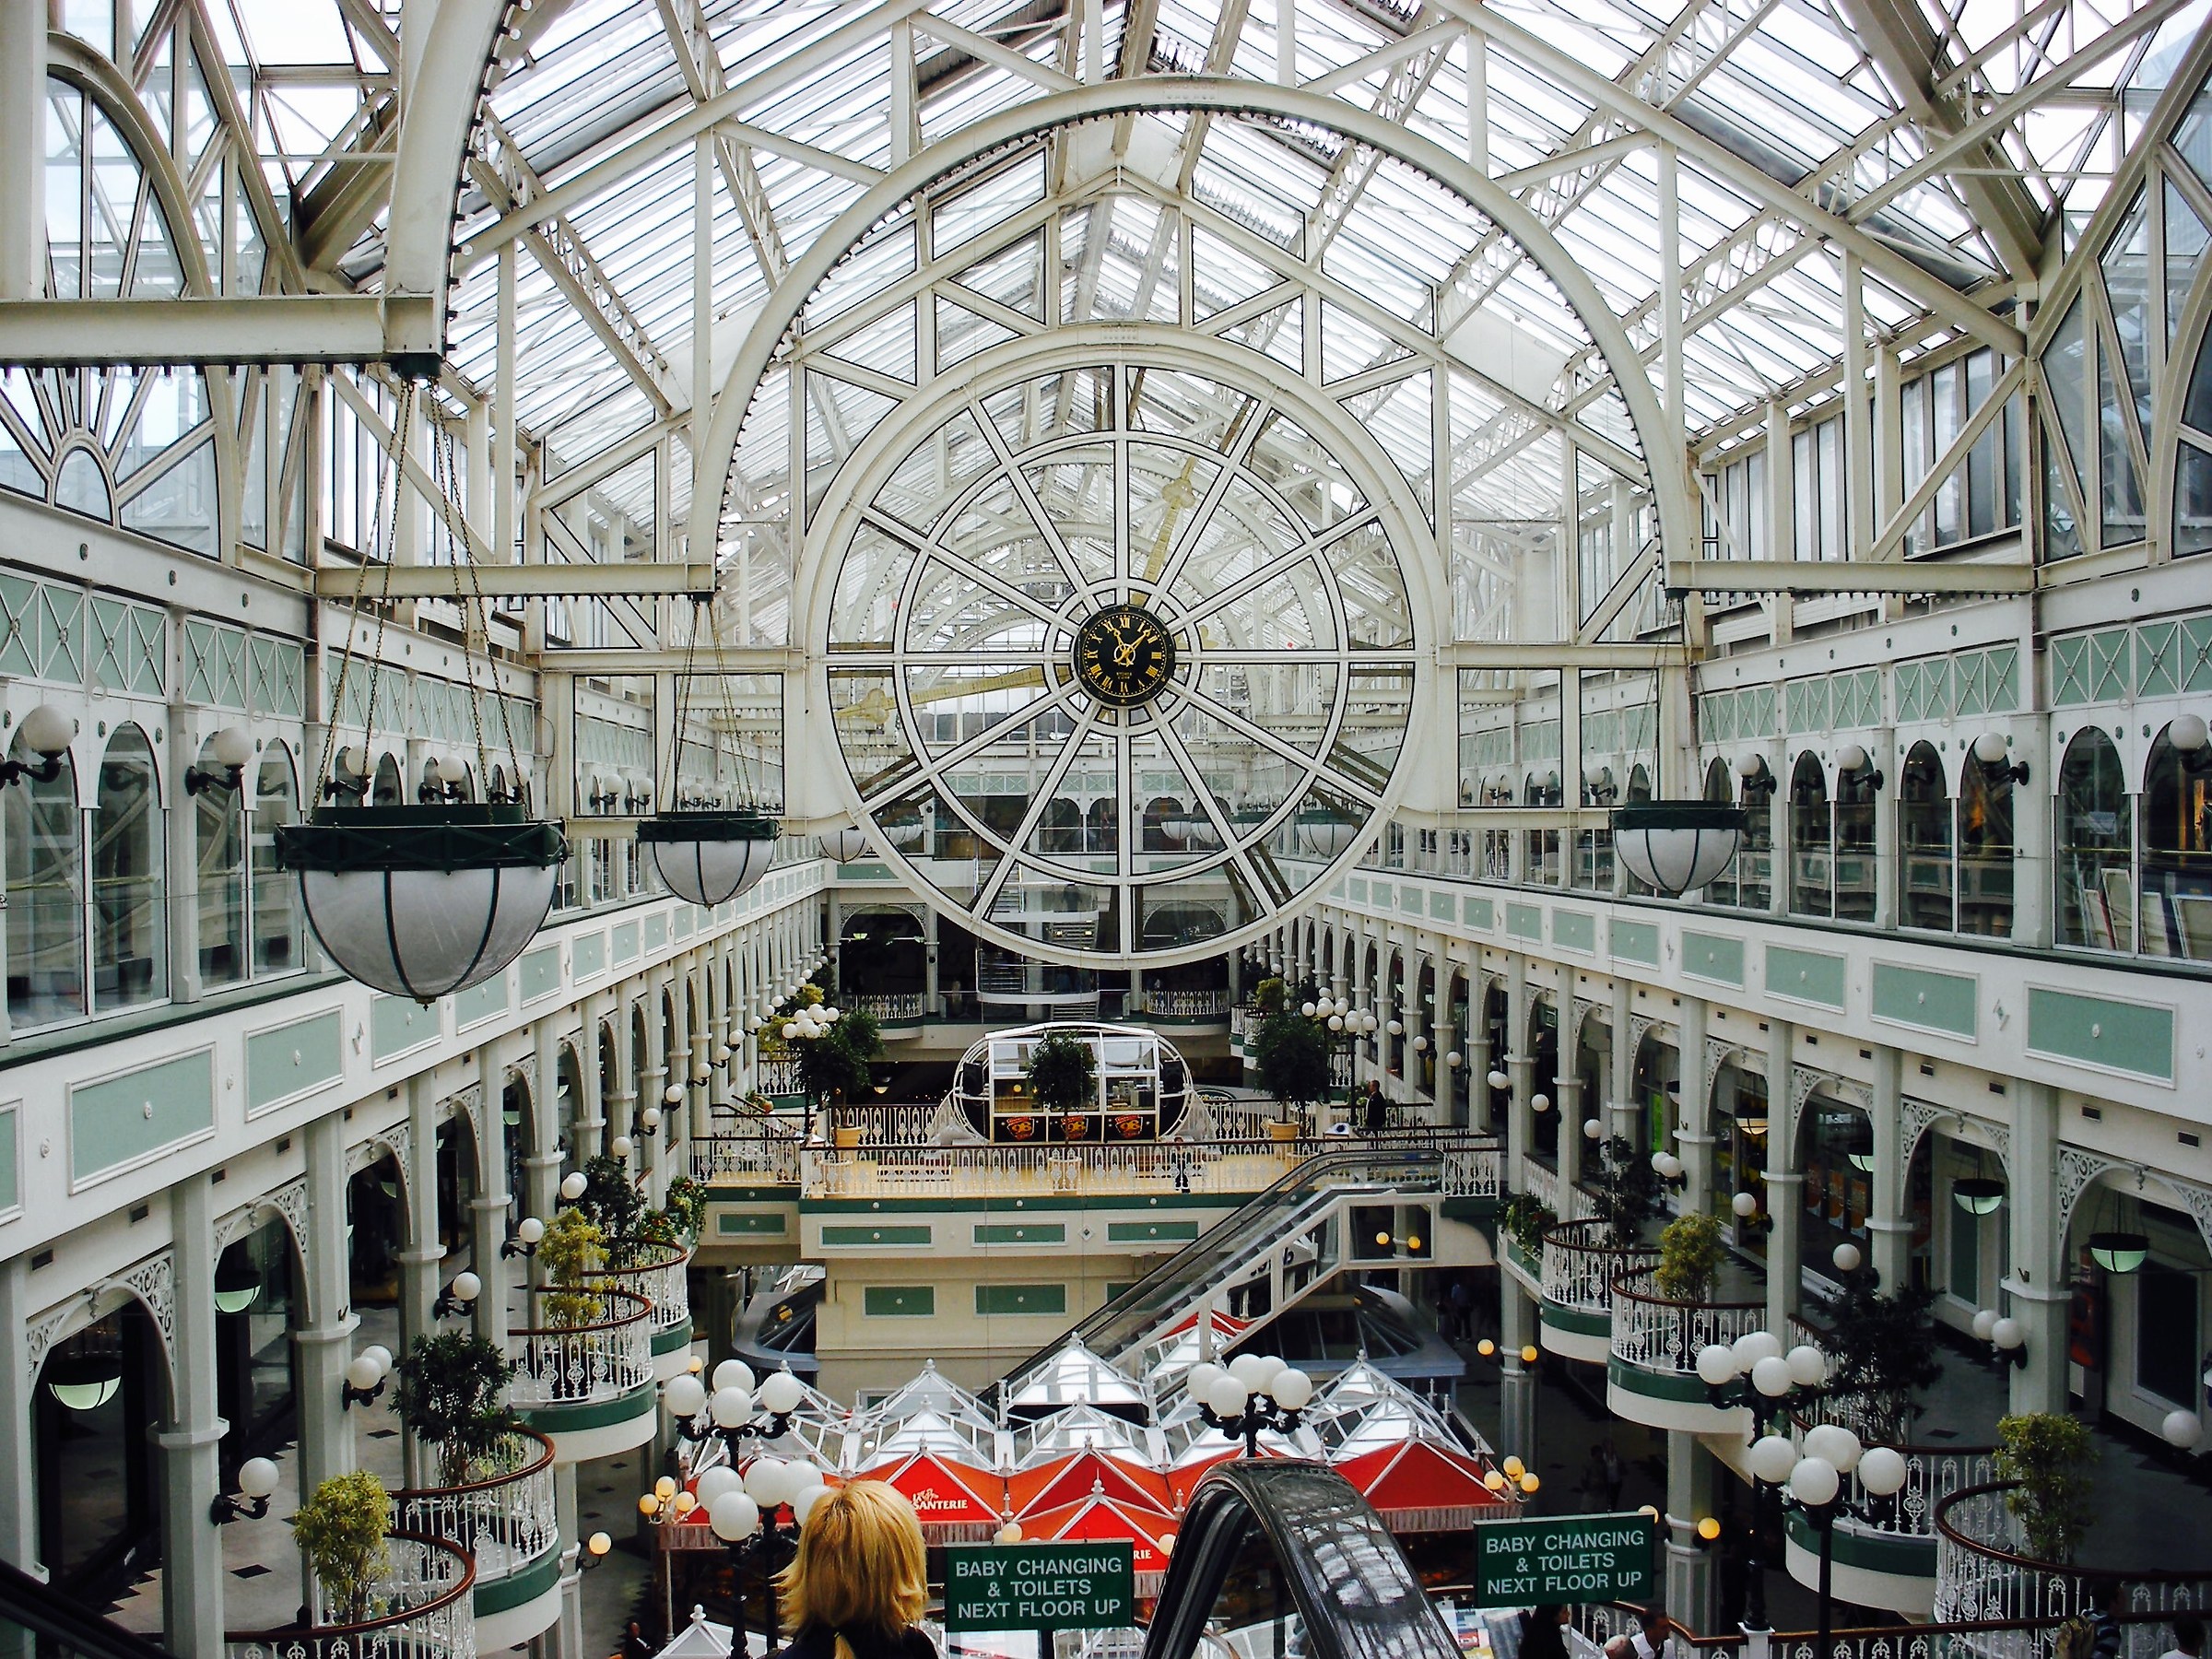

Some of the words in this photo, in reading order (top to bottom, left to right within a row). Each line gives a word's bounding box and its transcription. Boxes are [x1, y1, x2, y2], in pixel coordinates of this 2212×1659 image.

[1120, 618, 1131, 629] XII
[1091, 633, 1103, 644] X
[1151, 652, 1162, 660] III
[912, 1500, 968, 1511] SANTERIE
[1487, 1536, 1535, 1553] BABY
[1545, 1531, 1643, 1550] CHANGING
[957, 1561, 1007, 1576] BABY
[1017, 1558, 1122, 1575] CHANGING
[1516, 1558, 1528, 1572] &
[1538, 1553, 1614, 1571] TOILETS
[988, 1583, 1000, 1597] &
[1010, 1580, 1090, 1596] TOILETS
[1488, 1578, 1536, 1594] NEXT
[1546, 1574, 1608, 1591] FLOOR
[1618, 1571, 1641, 1586] UP
[959, 1603, 1010, 1618] NEXT
[1019, 1601, 1085, 1617] FLOOR
[1095, 1599, 1120, 1614] UP
